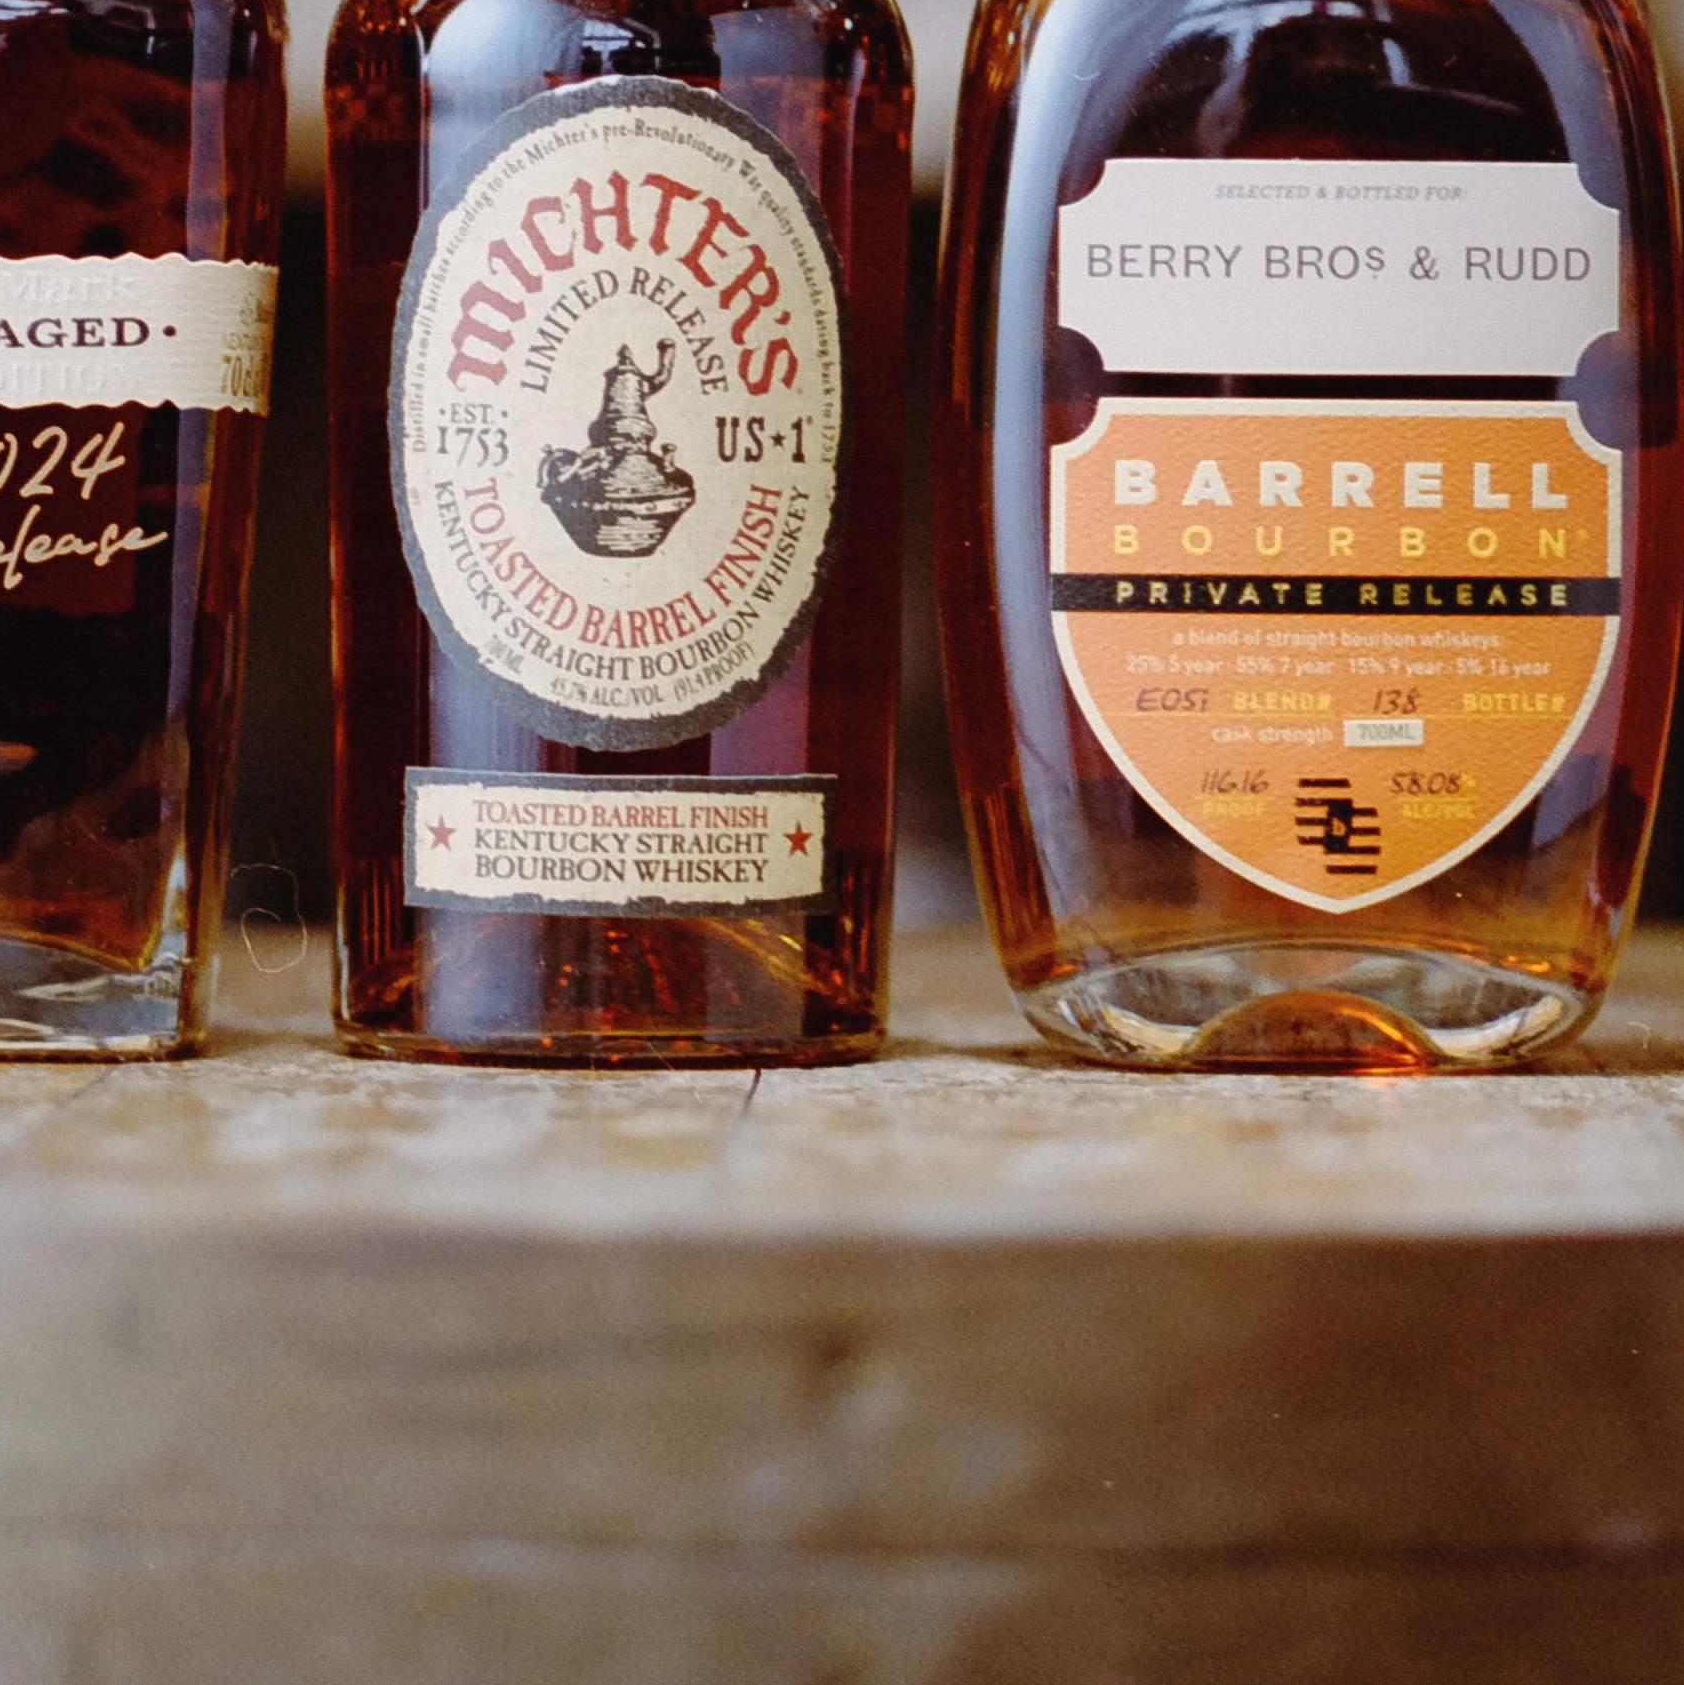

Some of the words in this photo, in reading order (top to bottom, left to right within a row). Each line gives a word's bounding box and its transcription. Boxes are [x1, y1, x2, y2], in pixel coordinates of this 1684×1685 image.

[523, 122, 600, 166] Michter's
[602, 117, 736, 173] pre-Revolutionary
[488, 176, 505, 194] to
[502, 157, 527, 180] the
[1214, 183, 1311, 201] SELECTED
[1333, 185, 1420, 201] BOTTLED
[446, 190, 495, 257] according
[758, 189, 796, 237] quality
[446, 169, 800, 397] MICHTER'S
[1086, 243, 1242, 280] BERRY
[1409, 245, 1441, 282] &
[1465, 247, 1592, 283] RUDD
[422, 258, 451, 313] batches
[417, 316, 433, 359] small
[519, 268, 620, 394] LIMITED
[627, 265, 730, 396] RELEASE
[821, 361, 836, 396] back
[449, 402, 497, 425] EST.
[437, 425, 510, 468] 1753
[1114, 459, 1569, 511] BARRELL
[1113, 524, 1567, 559] BOURBON
[434, 480, 513, 623] KENTUCKY
[504, 615, 634, 681] STRAIGHT
[640, 600, 761, 681] BOURBON
[751, 484, 811, 604] WHISKEY
[464, 476, 579, 632] TOASTED
[577, 591, 718, 650] BARREL
[703, 482, 783, 607] FINISH
[1116, 581, 1324, 607] PRIVATE
[1358, 582, 1569, 608] RELEASE
[1172, 631, 1184, 646] a
[1188, 628, 1239, 646] blend
[1243, 629, 1262, 646] of
[1266, 628, 1337, 651] straight
[1340, 630, 1416, 648] bourbon
[703, 640, 756, 687] PROOF)
[1183, 659, 1224, 676] year
[1278, 656, 1291, 674] 7
[1294, 660, 1335, 677] year
[1348, 656, 1385, 675] 15%
[1405, 661, 1444, 678] year
[1513, 662, 1552, 679] year
[1211, 725, 1253, 743] cask
[1258, 726, 1334, 747] strength
[472, 799, 588, 828] TOASTED
[591, 803, 686, 829] BARREL
[689, 805, 769, 830] FINISH
[474, 828, 632, 854] KENTUCKY
[635, 831, 769, 855] STRAIGHT
[475, 854, 626, 883] BOURBON
[632, 858, 770, 884] WHISKEY
